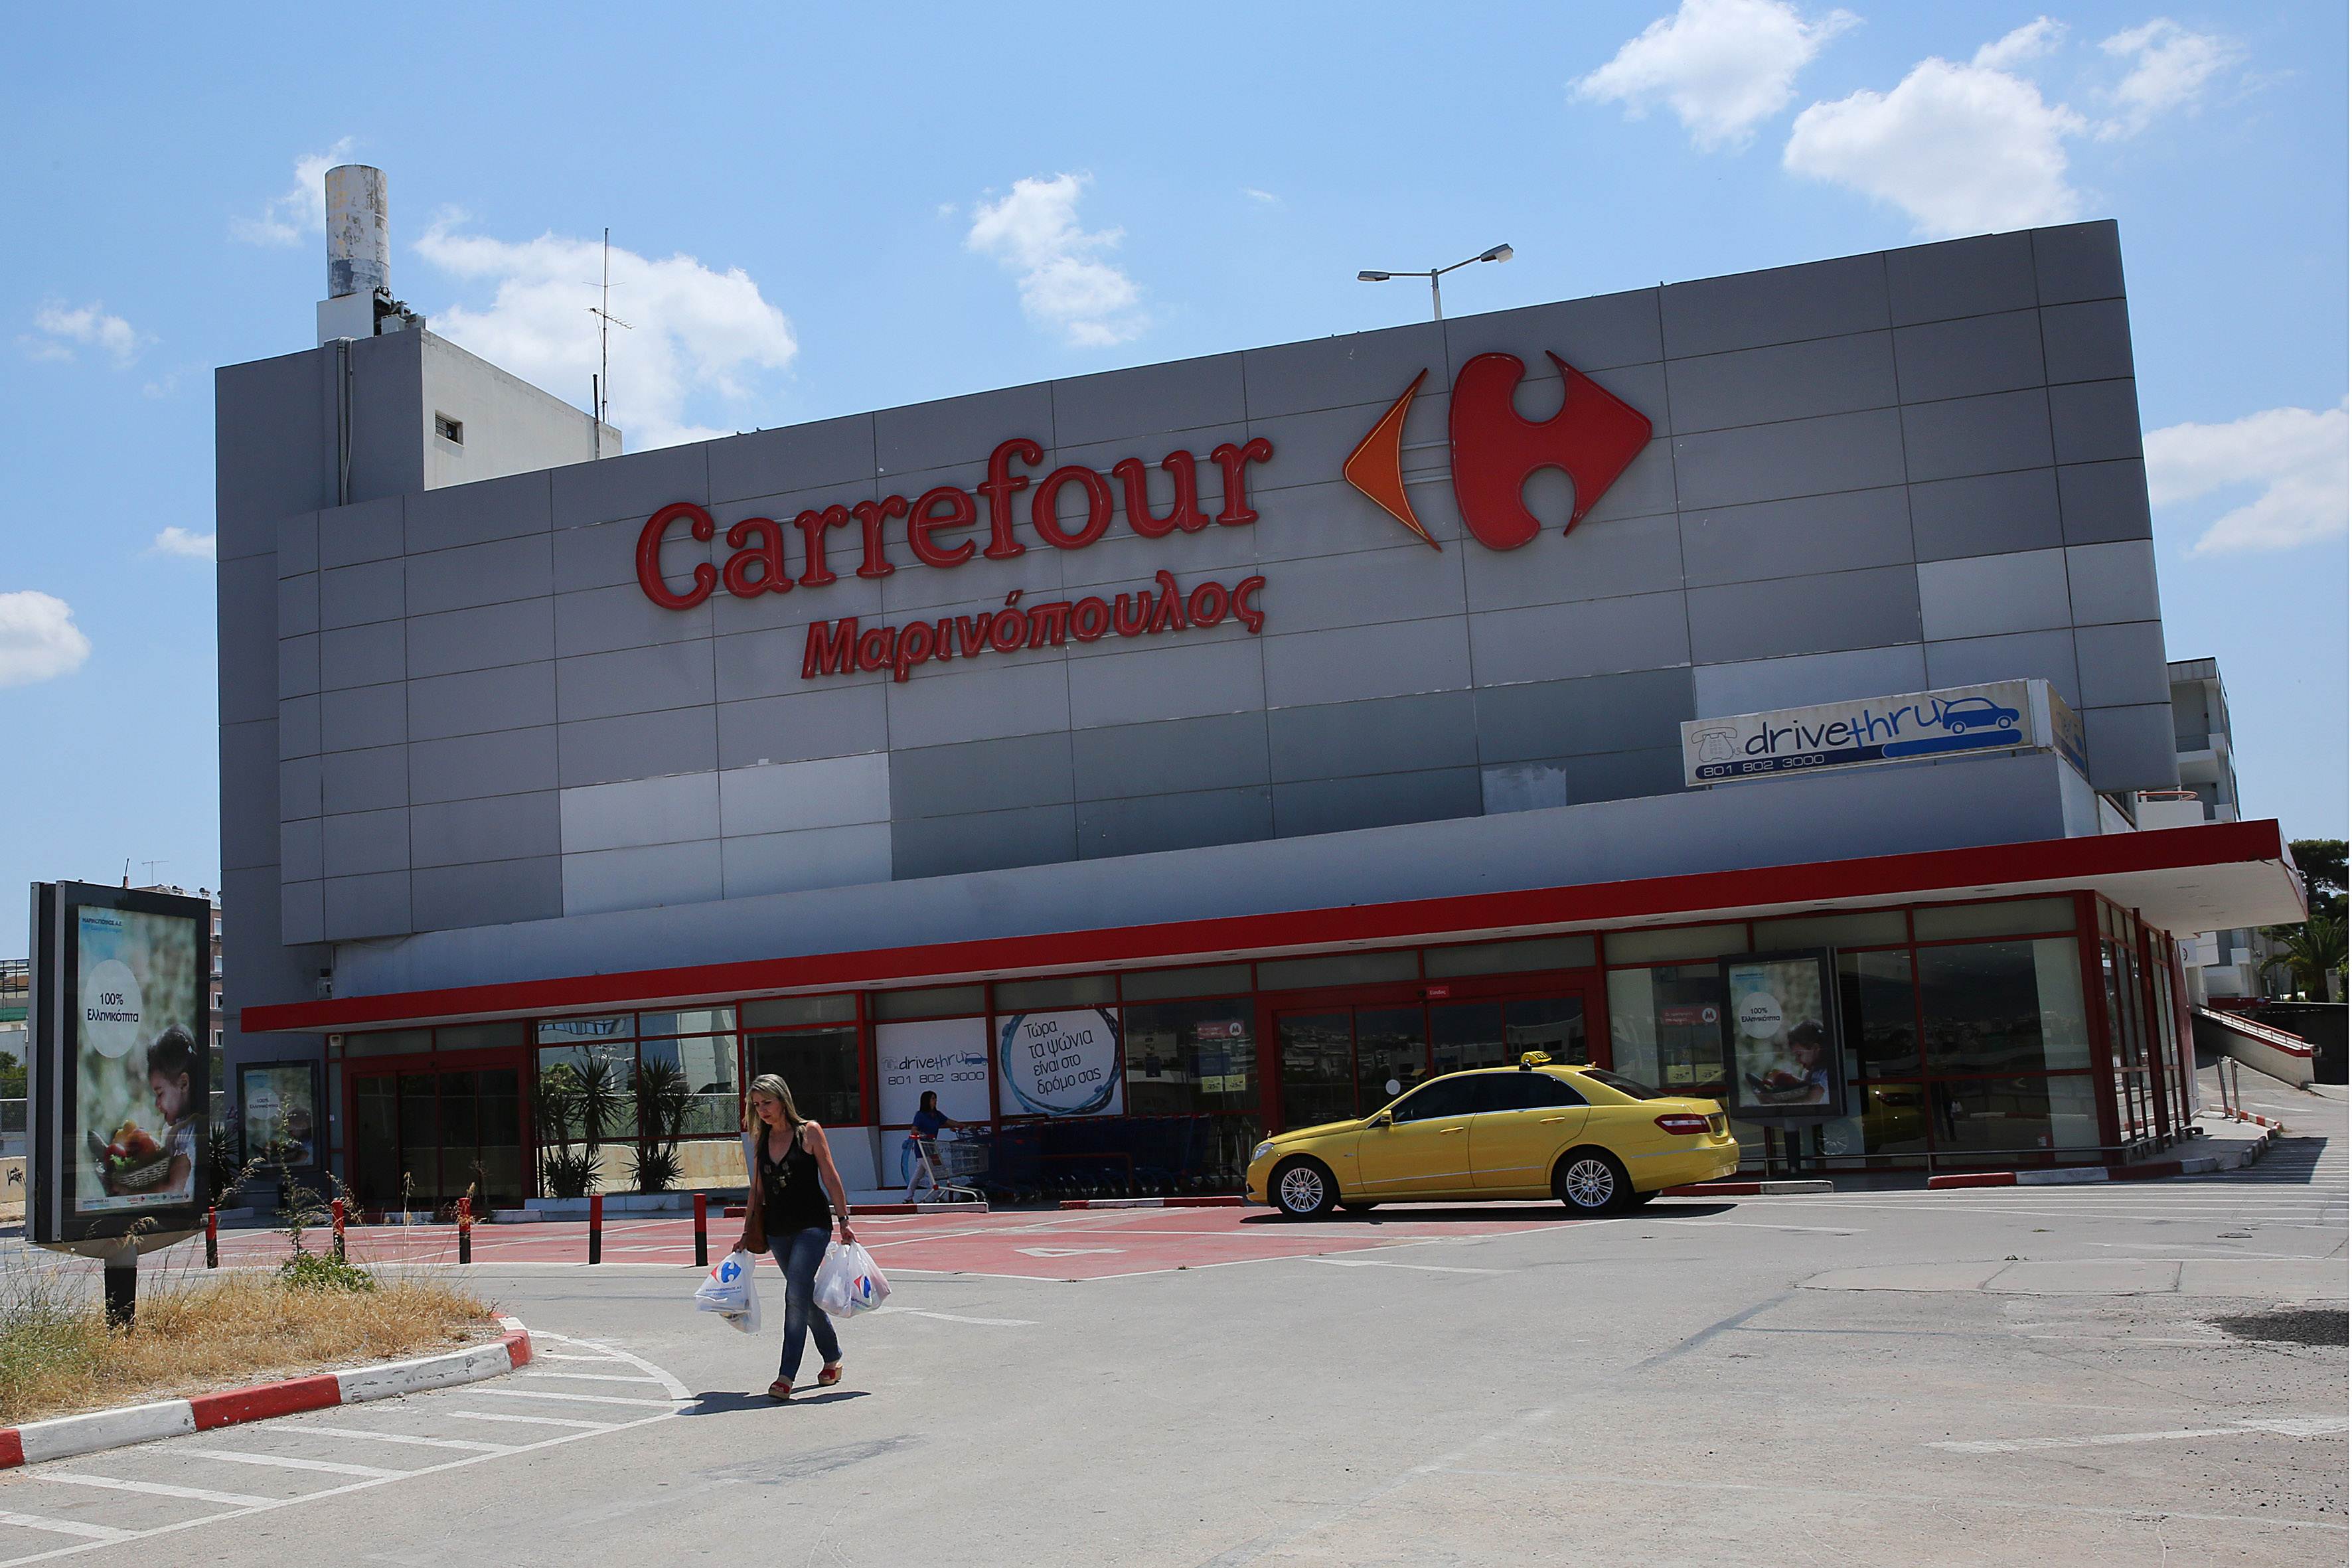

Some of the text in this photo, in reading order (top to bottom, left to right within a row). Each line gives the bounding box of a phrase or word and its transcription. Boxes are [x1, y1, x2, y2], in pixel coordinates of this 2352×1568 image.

[635, 438, 1273, 610] Carrefour
[801, 570, 1266, 682] Μαρινόπουλος
[1703, 754, 1824, 777] 801 802 3000
[100, 992, 123, 1006] 100%
[87, 1008, 139, 1022] Ελληνικότητα
[1024, 1020, 1058, 1038] Τώρα
[1028, 1030, 1094, 1058] τα ψώνια
[1034, 1054, 1081, 1076] είναι στο
[888, 1071, 985, 1085] 801 802 3000
[1037, 1067, 1101, 1096] δρόμο σας
